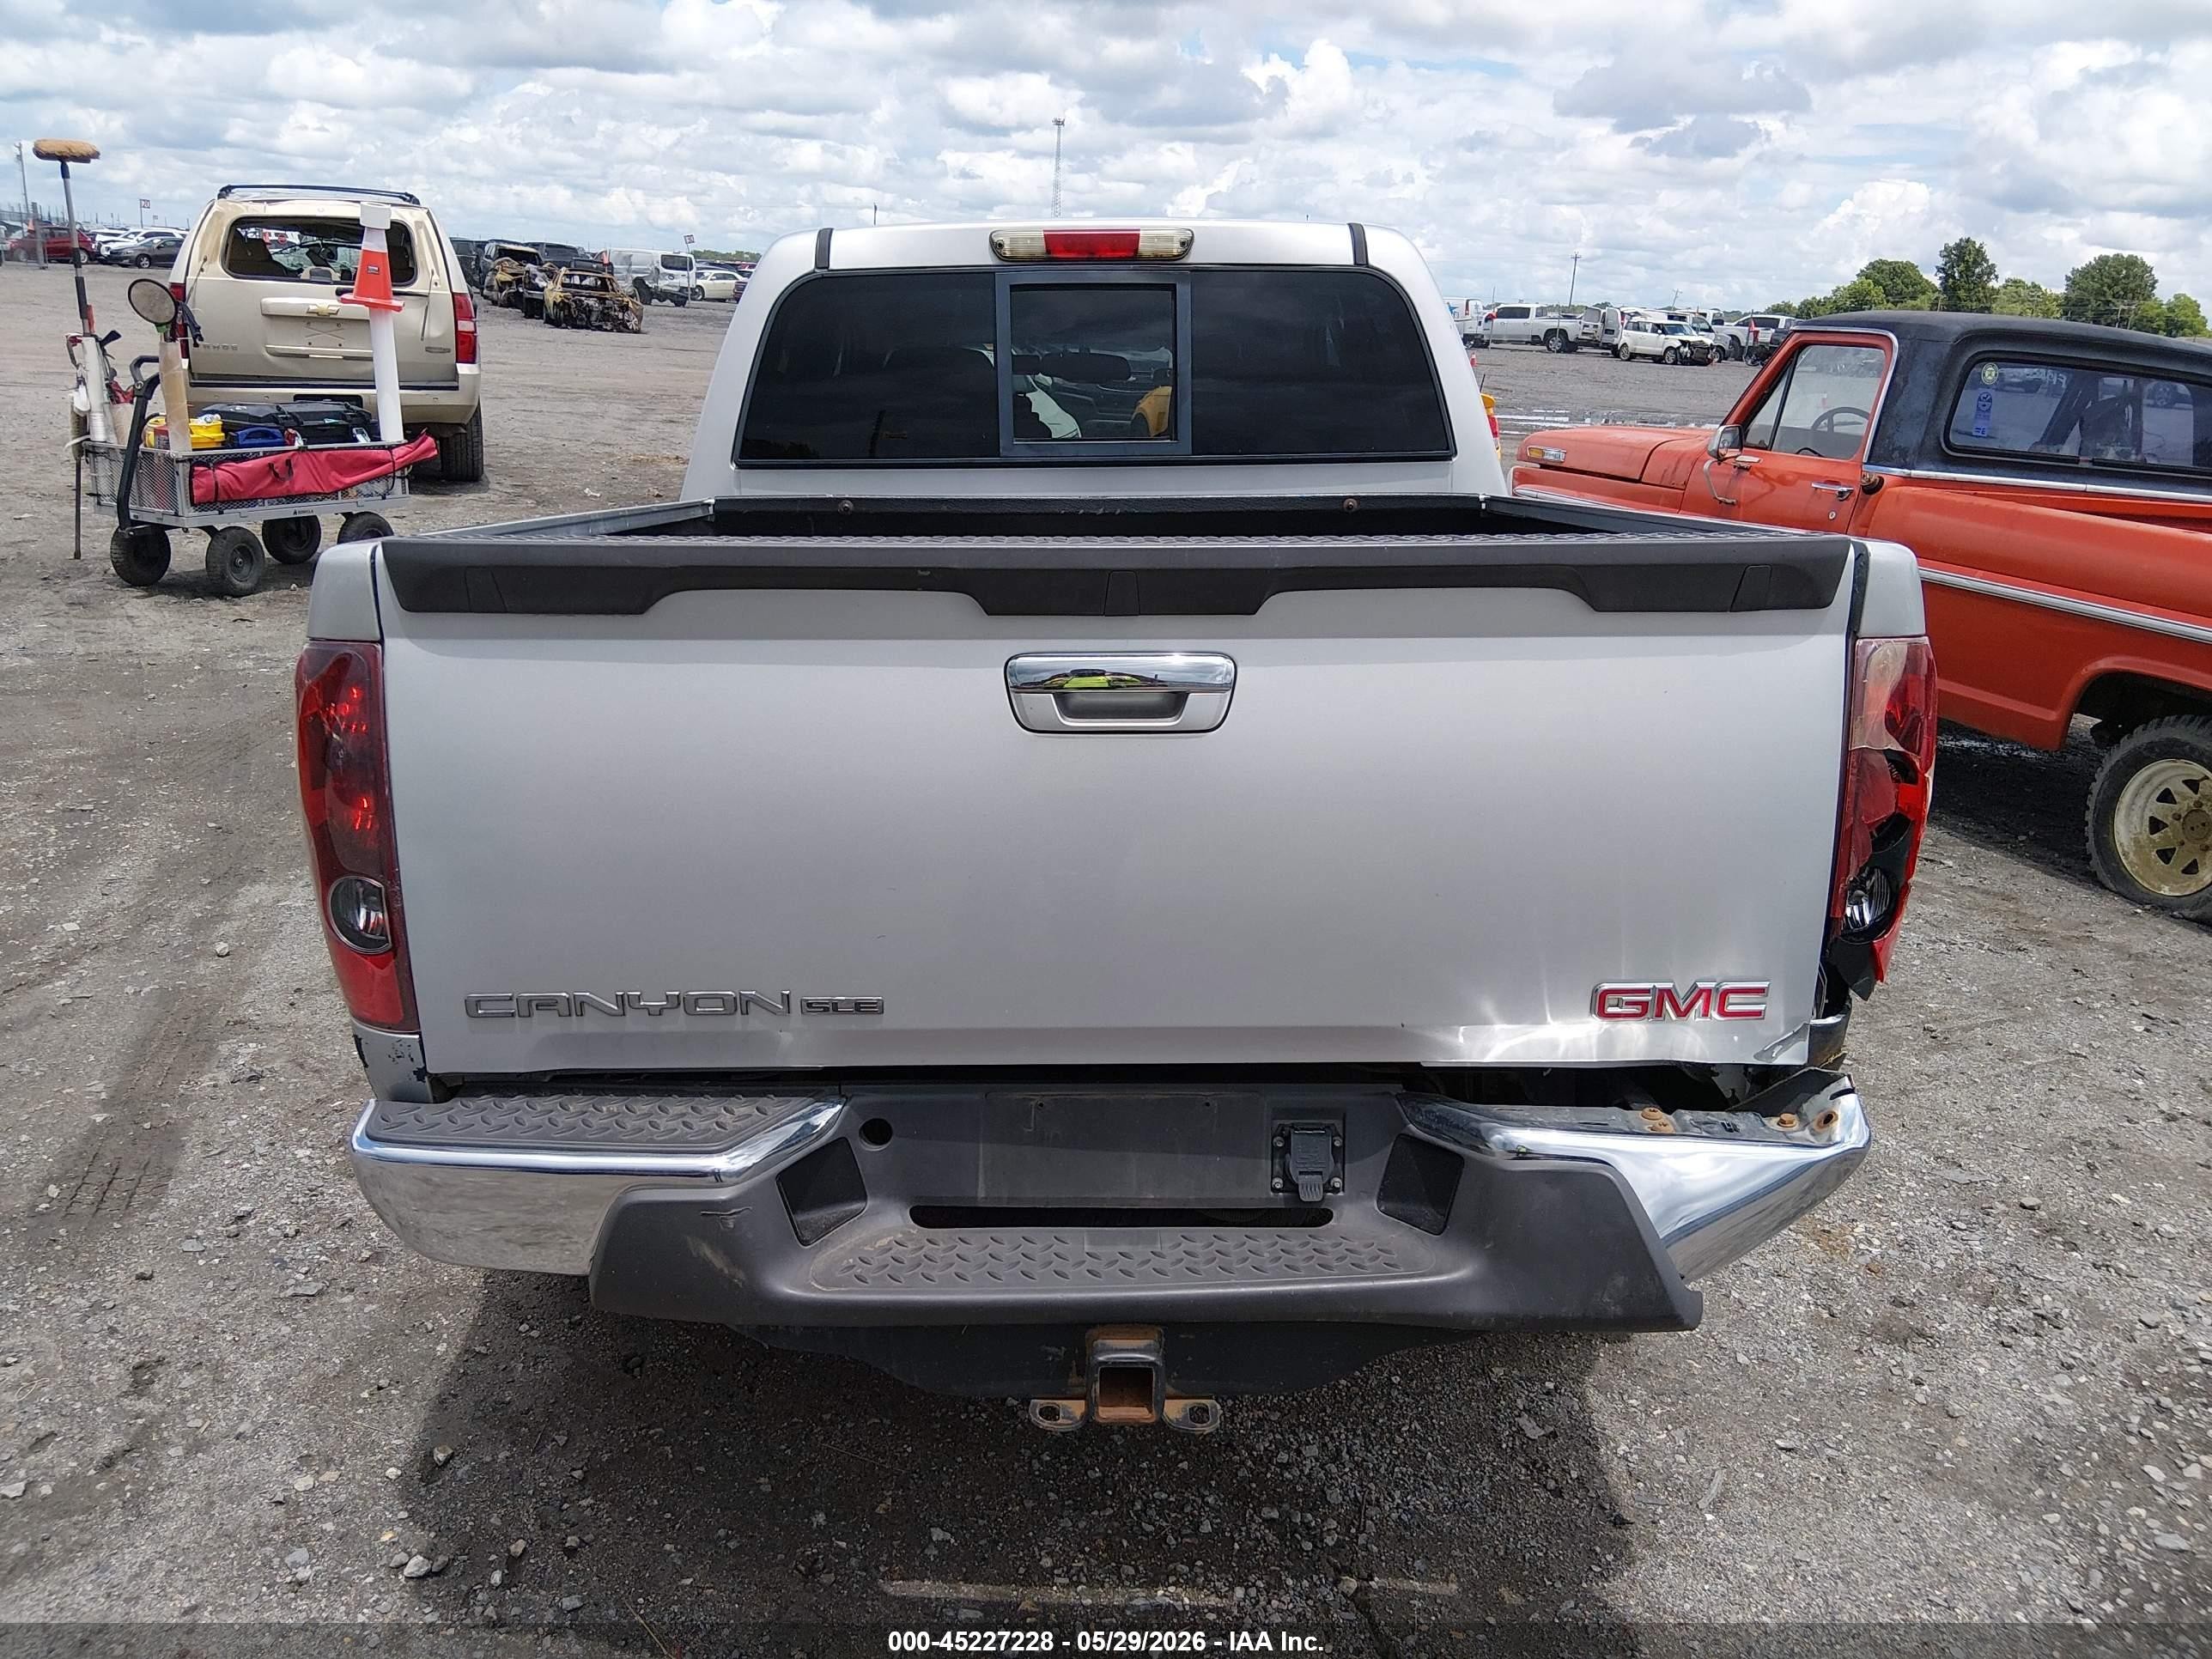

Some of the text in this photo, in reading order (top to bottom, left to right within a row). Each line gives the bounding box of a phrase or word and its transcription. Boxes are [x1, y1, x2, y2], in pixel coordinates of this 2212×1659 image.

[465, 990, 884, 1018] CANYON SLE
[1590, 981, 1771, 1022] GMC
